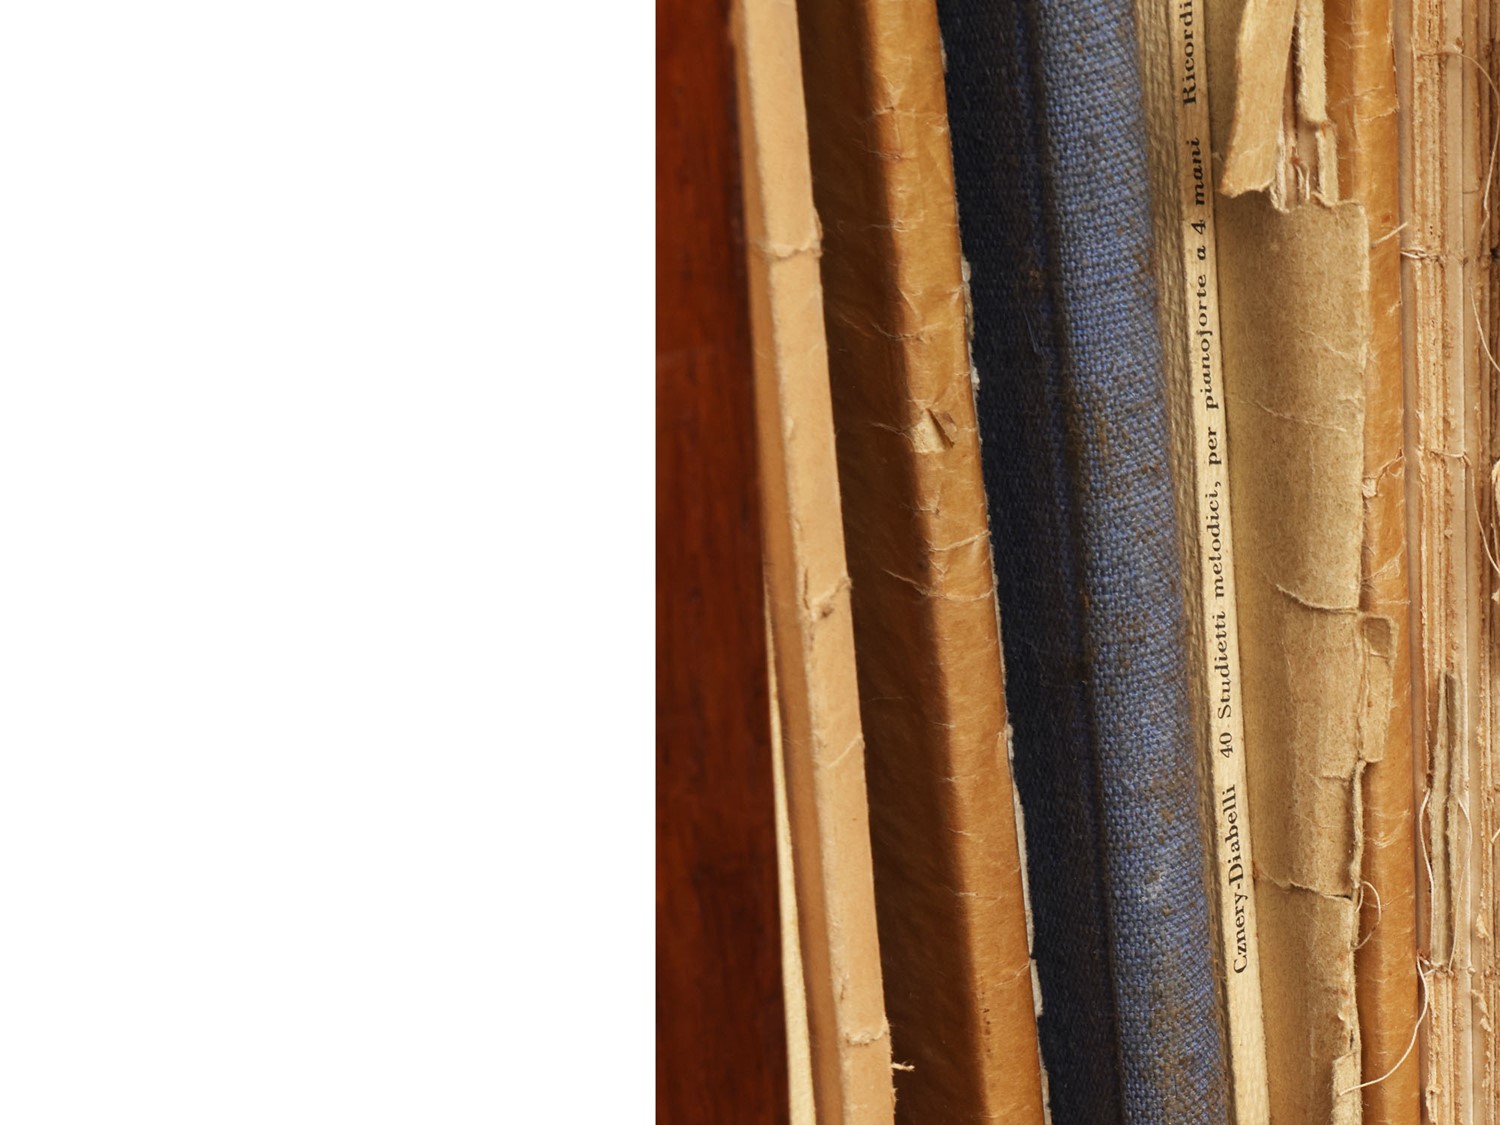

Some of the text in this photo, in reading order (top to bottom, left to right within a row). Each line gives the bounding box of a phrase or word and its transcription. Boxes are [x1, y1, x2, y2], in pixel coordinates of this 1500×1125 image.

[1180, 1, 1197, 105] Ricordi
[1186, 137, 1205, 206] mani
[1191, 219, 1207, 235] 4
[1197, 245, 1206, 261] a
[1207, 427, 1222, 466] per
[1205, 481, 1225, 600] melodici,
[1212, 610, 1232, 720] Studietti
[1219, 732, 1234, 759] 40
[1222, 784, 1248, 974] Cznery-Diabelli
